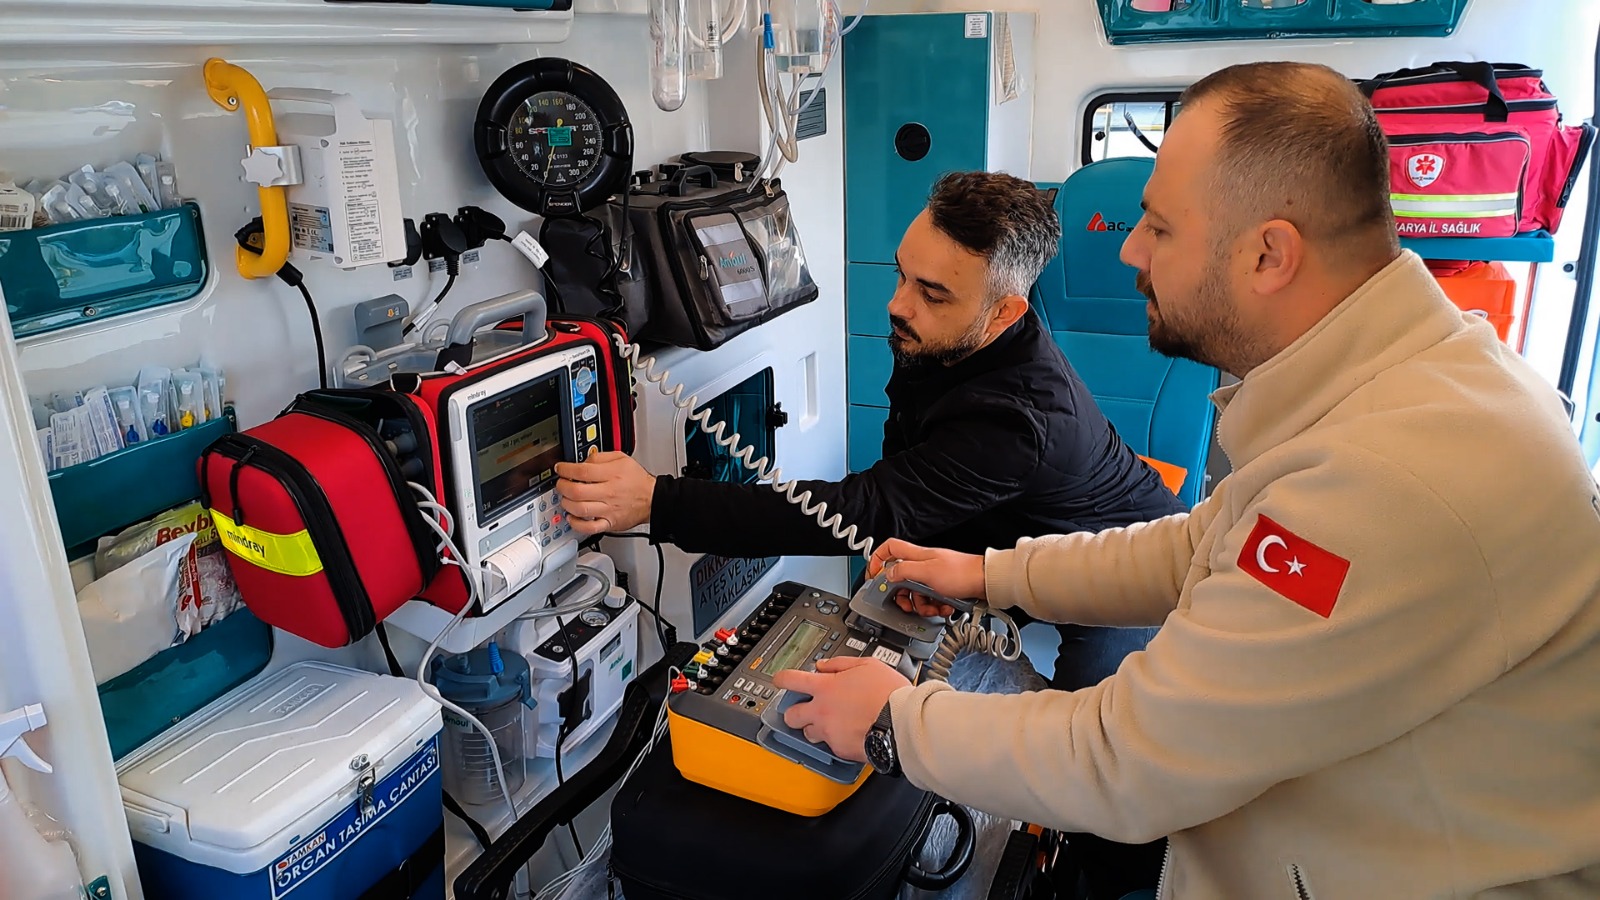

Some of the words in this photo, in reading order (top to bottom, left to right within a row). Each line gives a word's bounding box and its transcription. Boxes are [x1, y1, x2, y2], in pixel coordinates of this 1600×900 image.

[566, 103, 576, 111] 180
[575, 112, 586, 120] 200
[531, 163, 539, 171] 20
[568, 168, 580, 176] 300
[1429, 220, 1438, 234] İL
[1441, 221, 1482, 234] SAĞLIK
[576, 430, 582, 441] 2
[578, 451, 584, 462] 3
[226, 530, 265, 558] mindray
[699, 573, 727, 609] ATEŞ
[728, 561, 741, 581] VE
[714, 558, 767, 612] YAKLAŞMA
[278, 842, 336, 888] ORGAN
[389, 756, 436, 803] ÇANTASI
[286, 832, 325, 865] TAMKAN
